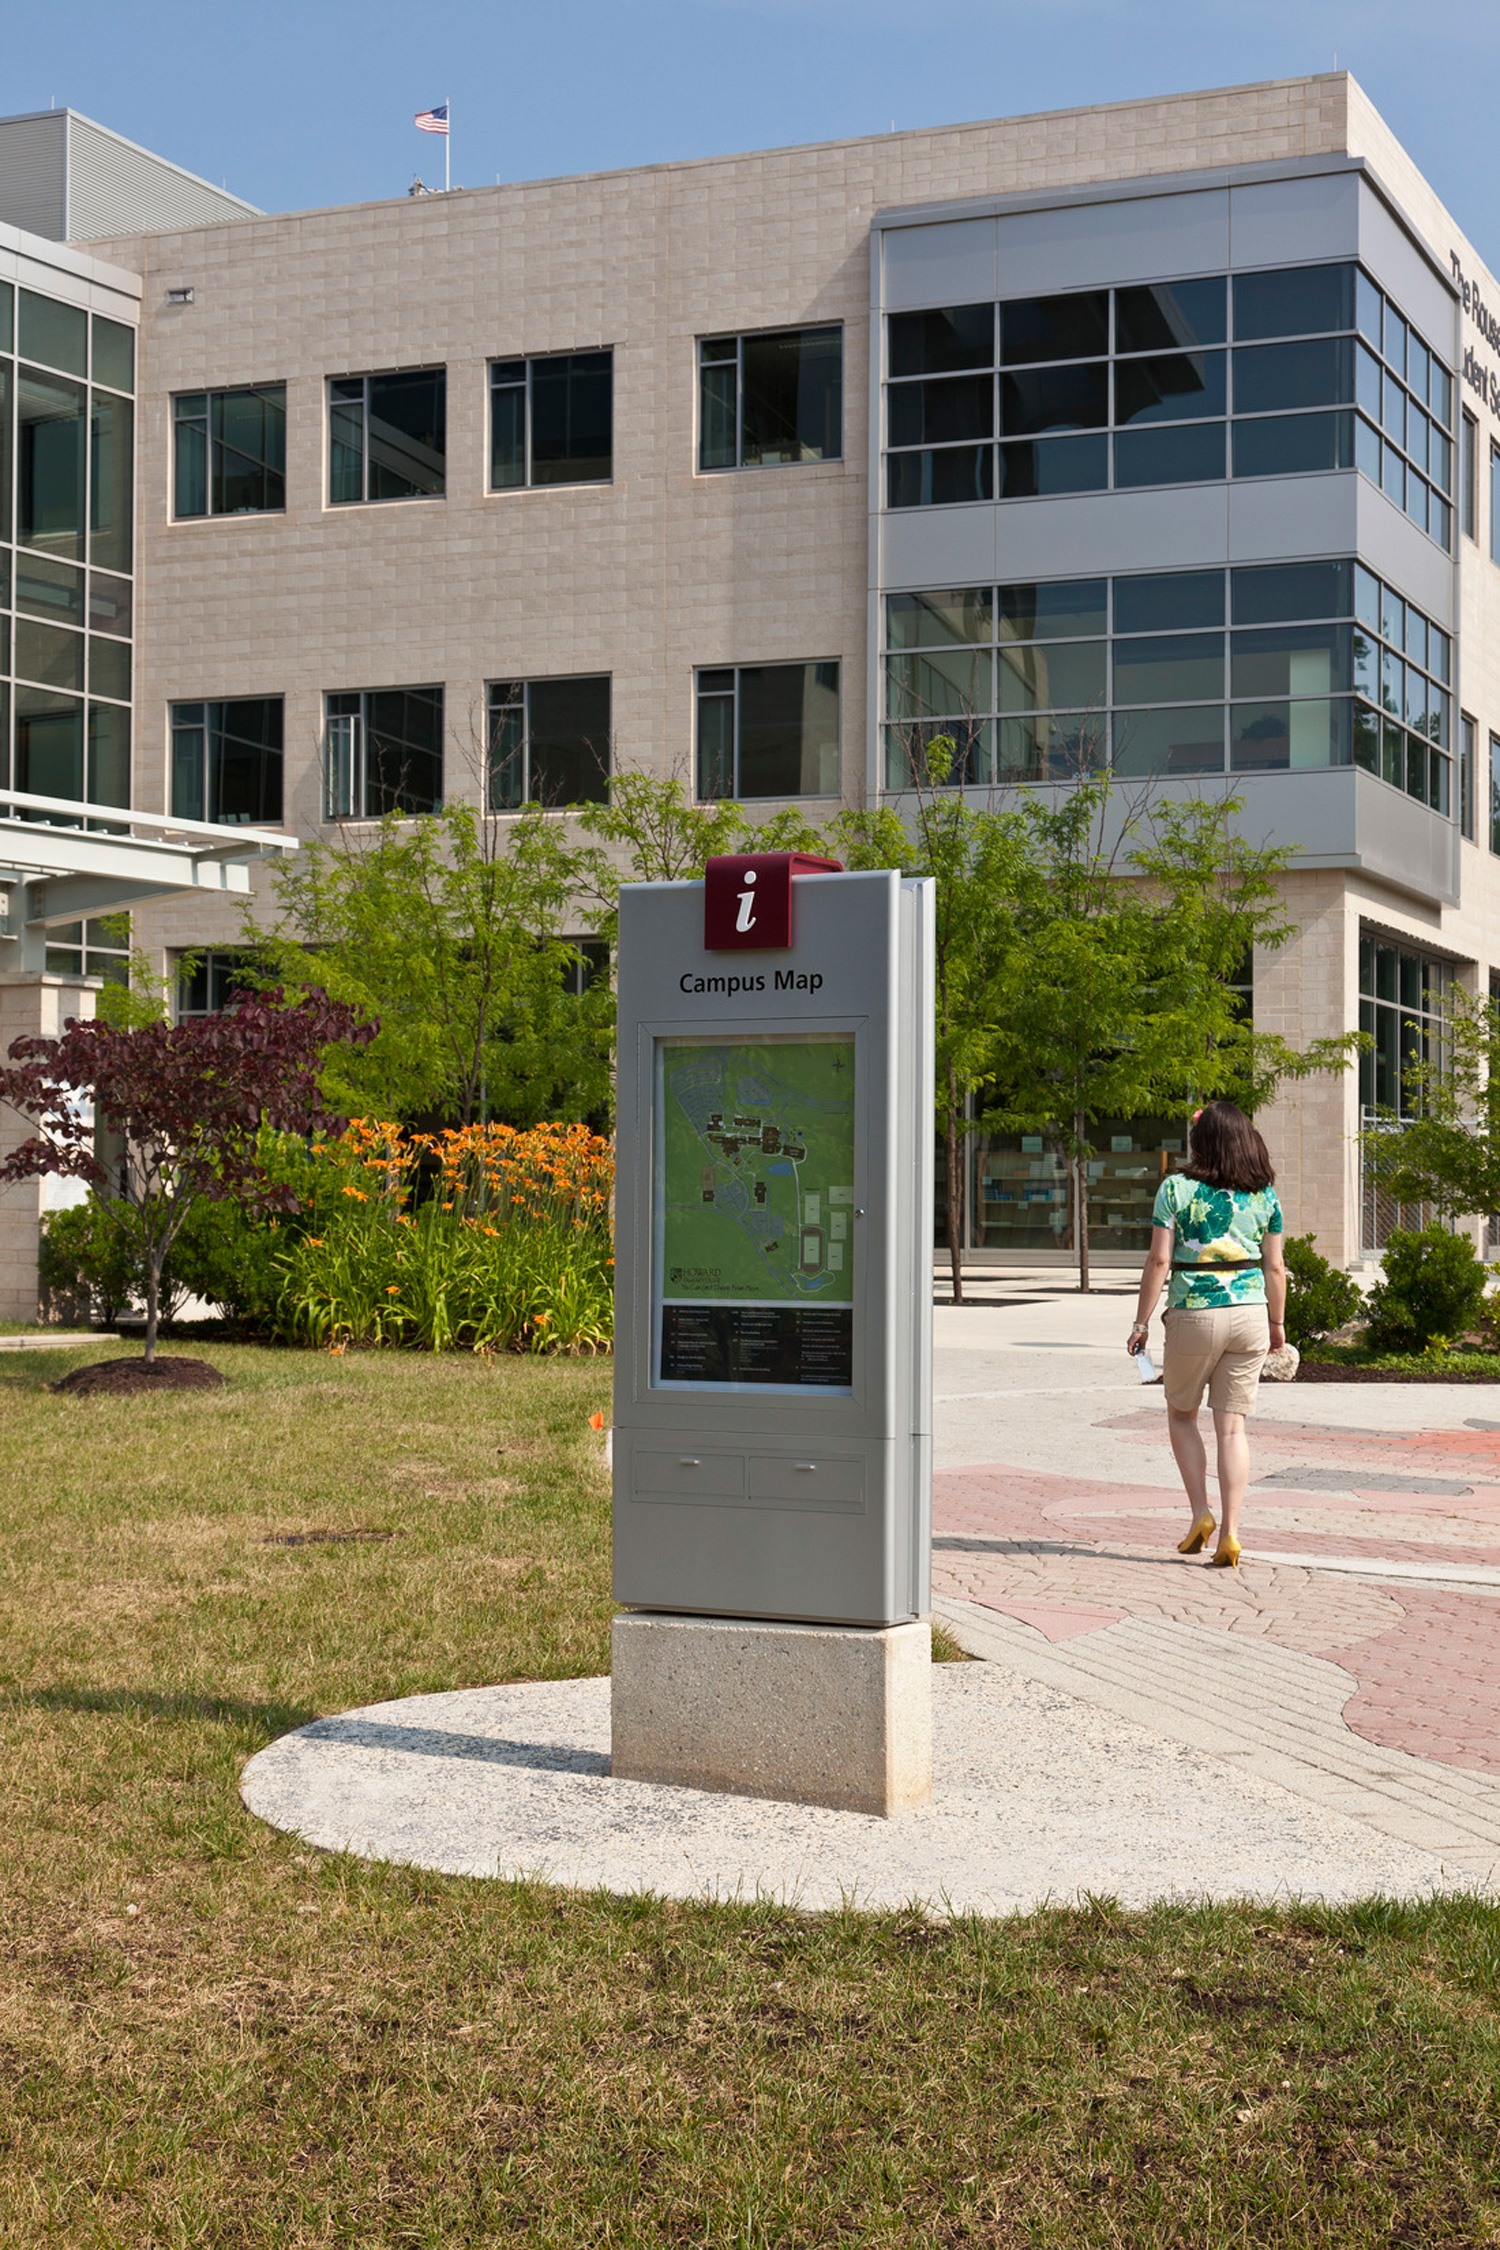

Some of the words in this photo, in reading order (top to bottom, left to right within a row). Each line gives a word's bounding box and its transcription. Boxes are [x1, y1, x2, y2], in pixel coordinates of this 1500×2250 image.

[1450, 249, 1470, 315] The
[735, 870, 757, 933] i
[679, 973, 765, 997] Campus
[774, 970, 823, 994] Map
